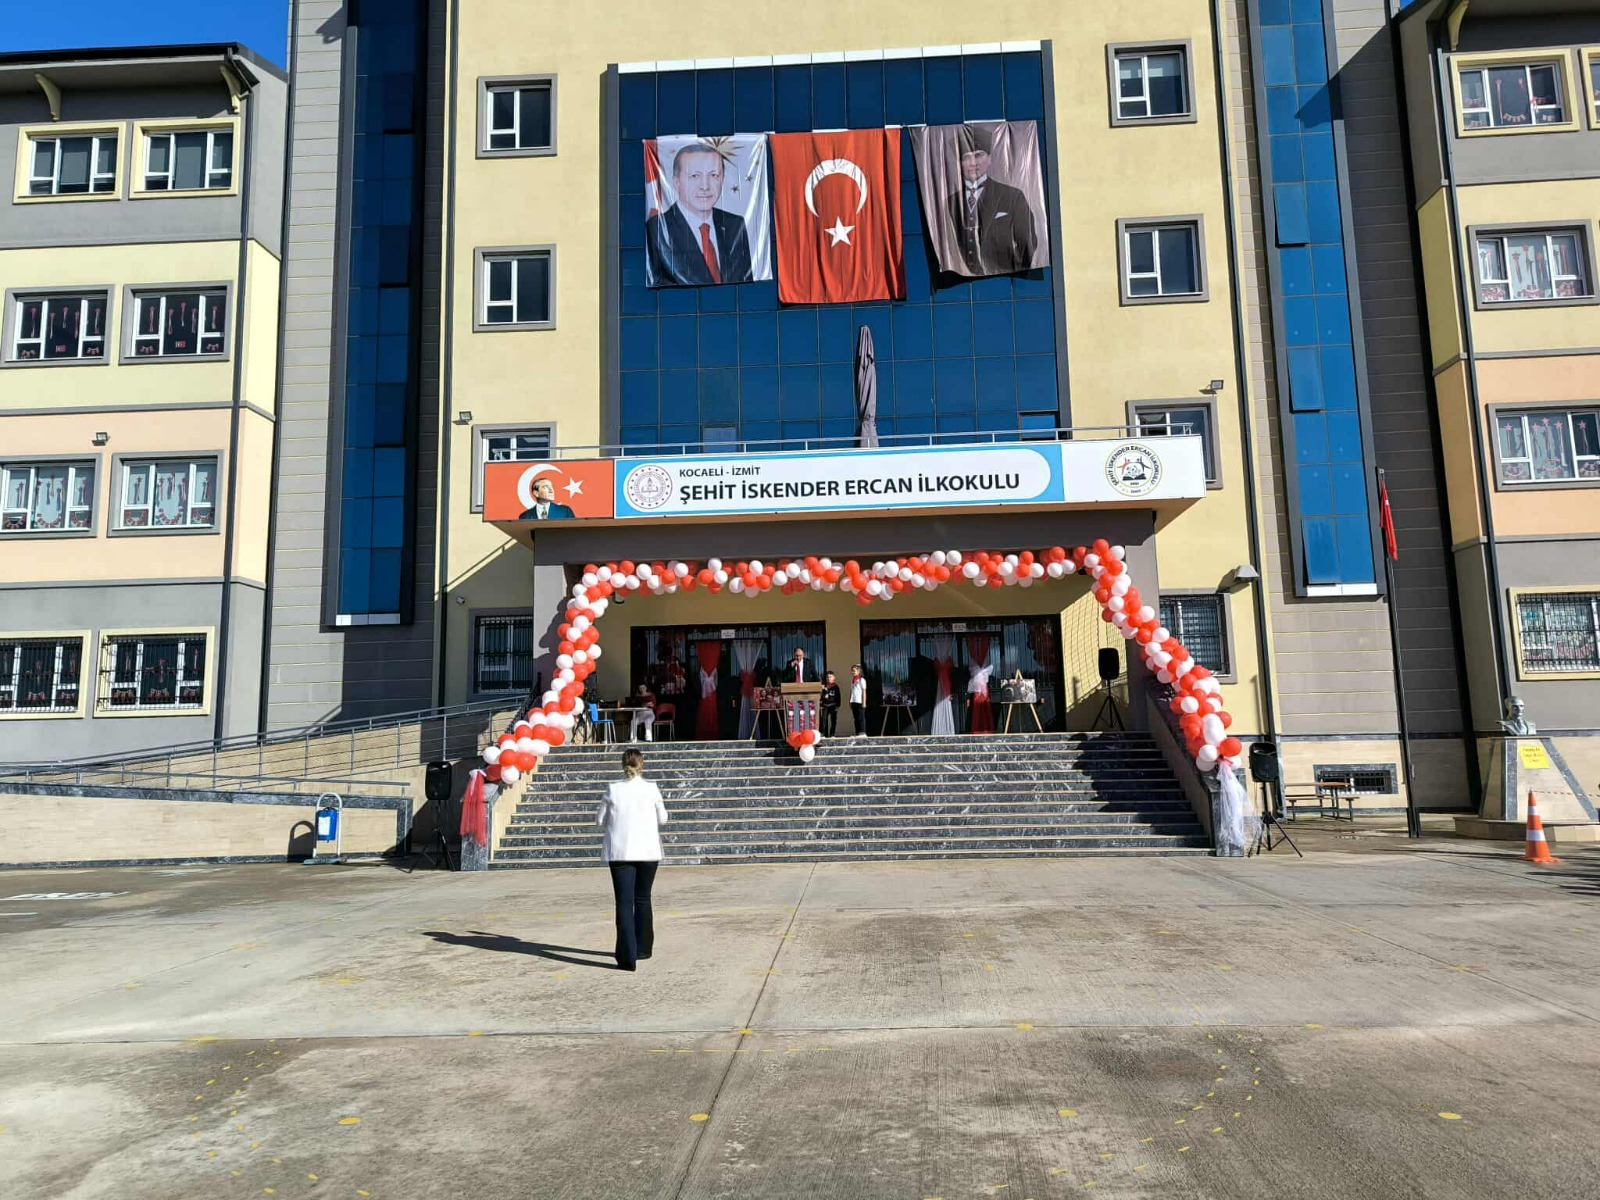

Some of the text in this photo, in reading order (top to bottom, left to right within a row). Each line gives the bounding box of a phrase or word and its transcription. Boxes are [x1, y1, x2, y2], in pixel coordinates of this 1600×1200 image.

[1131, 446, 1152, 457] ERCAN
[679, 467, 724, 477] KOCAELİ
[731, 465, 761, 477] İZMİT
[679, 480, 737, 504] ŞEHİT
[742, 479, 840, 499] İSKENDER
[845, 478, 913, 496] ERCAN
[918, 473, 1020, 493] İLKOKULU
